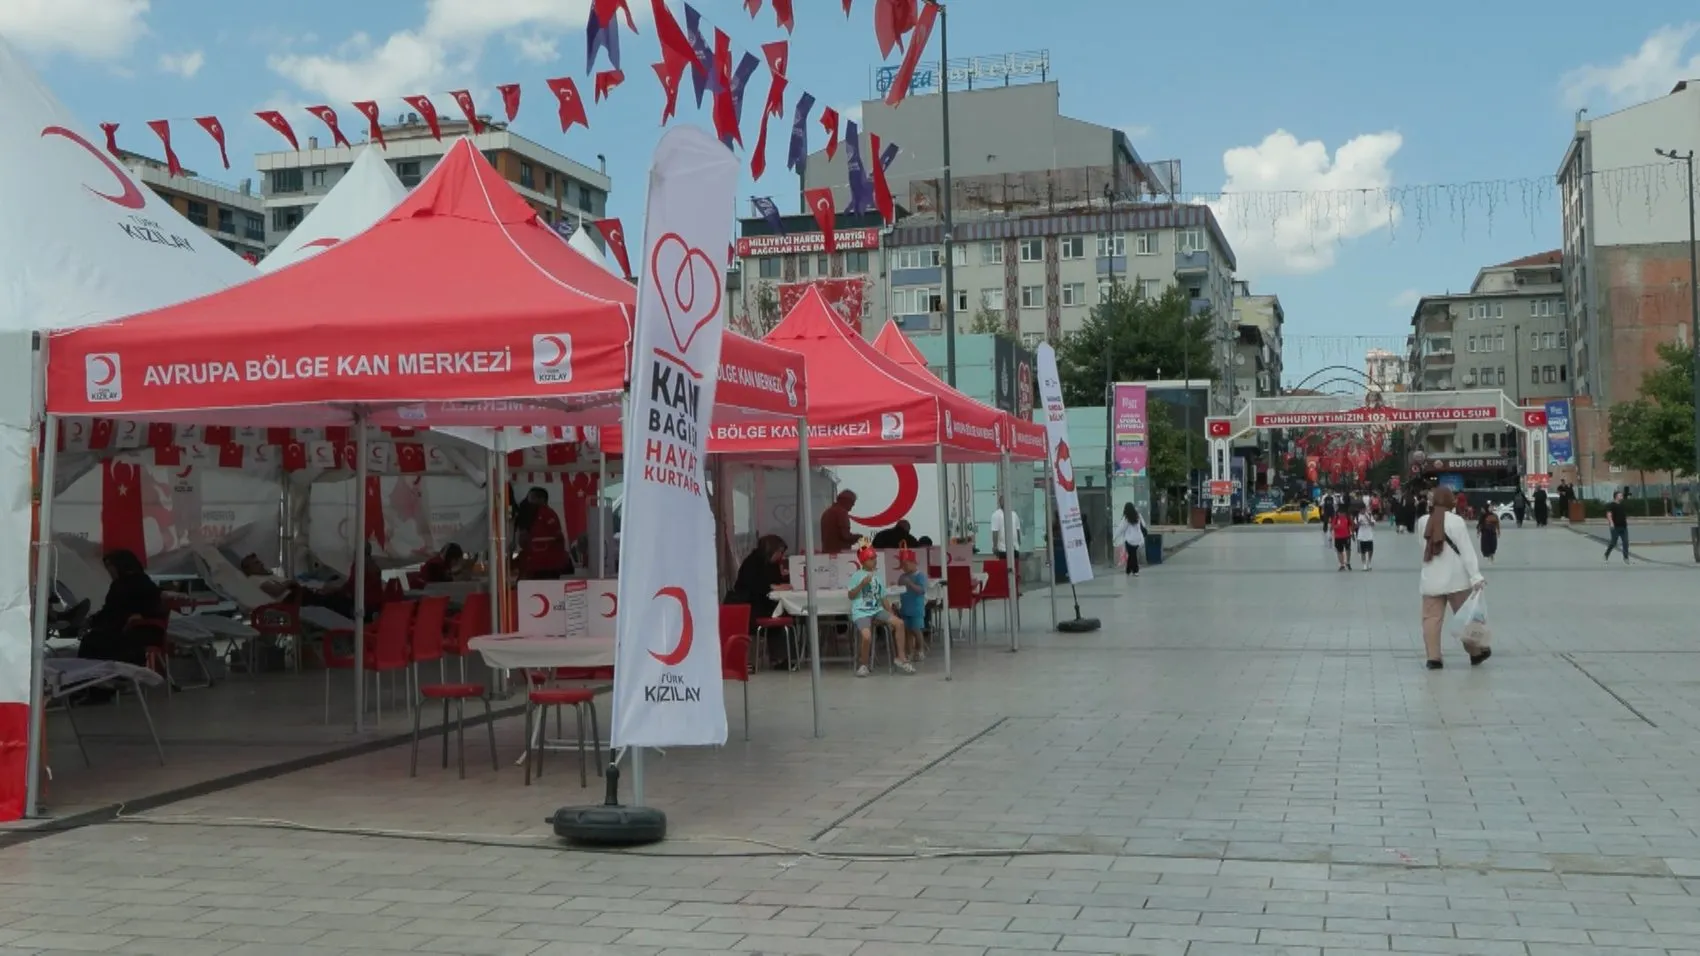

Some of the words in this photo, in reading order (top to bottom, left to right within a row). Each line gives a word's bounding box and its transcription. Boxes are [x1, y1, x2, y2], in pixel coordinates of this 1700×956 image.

[118, 222, 196, 253] KIZILAY
[793, 232, 826, 244] HAREKE
[812, 240, 864, 252] BAANLIĞI
[143, 361, 240, 386] AVRUPA
[245, 354, 329, 381] BÖLGE
[336, 354, 389, 376] KAN
[398, 345, 512, 374] MERKEZİ
[737, 367, 756, 388] KAN
[651, 361, 701, 423] KAN
[1392, 410, 1413, 420] YILI
[1414, 410, 1451, 419] KUTLU
[1452, 408, 1491, 418] OLSUN
[717, 424, 767, 440] BÖLGE
[771, 425, 800, 439] KAN
[806, 419, 871, 438] MERKEZİ
[1448, 459, 1485, 468] BURGER
[660, 672, 685, 684] TÜRK
[644, 685, 701, 702] KIZILAY
